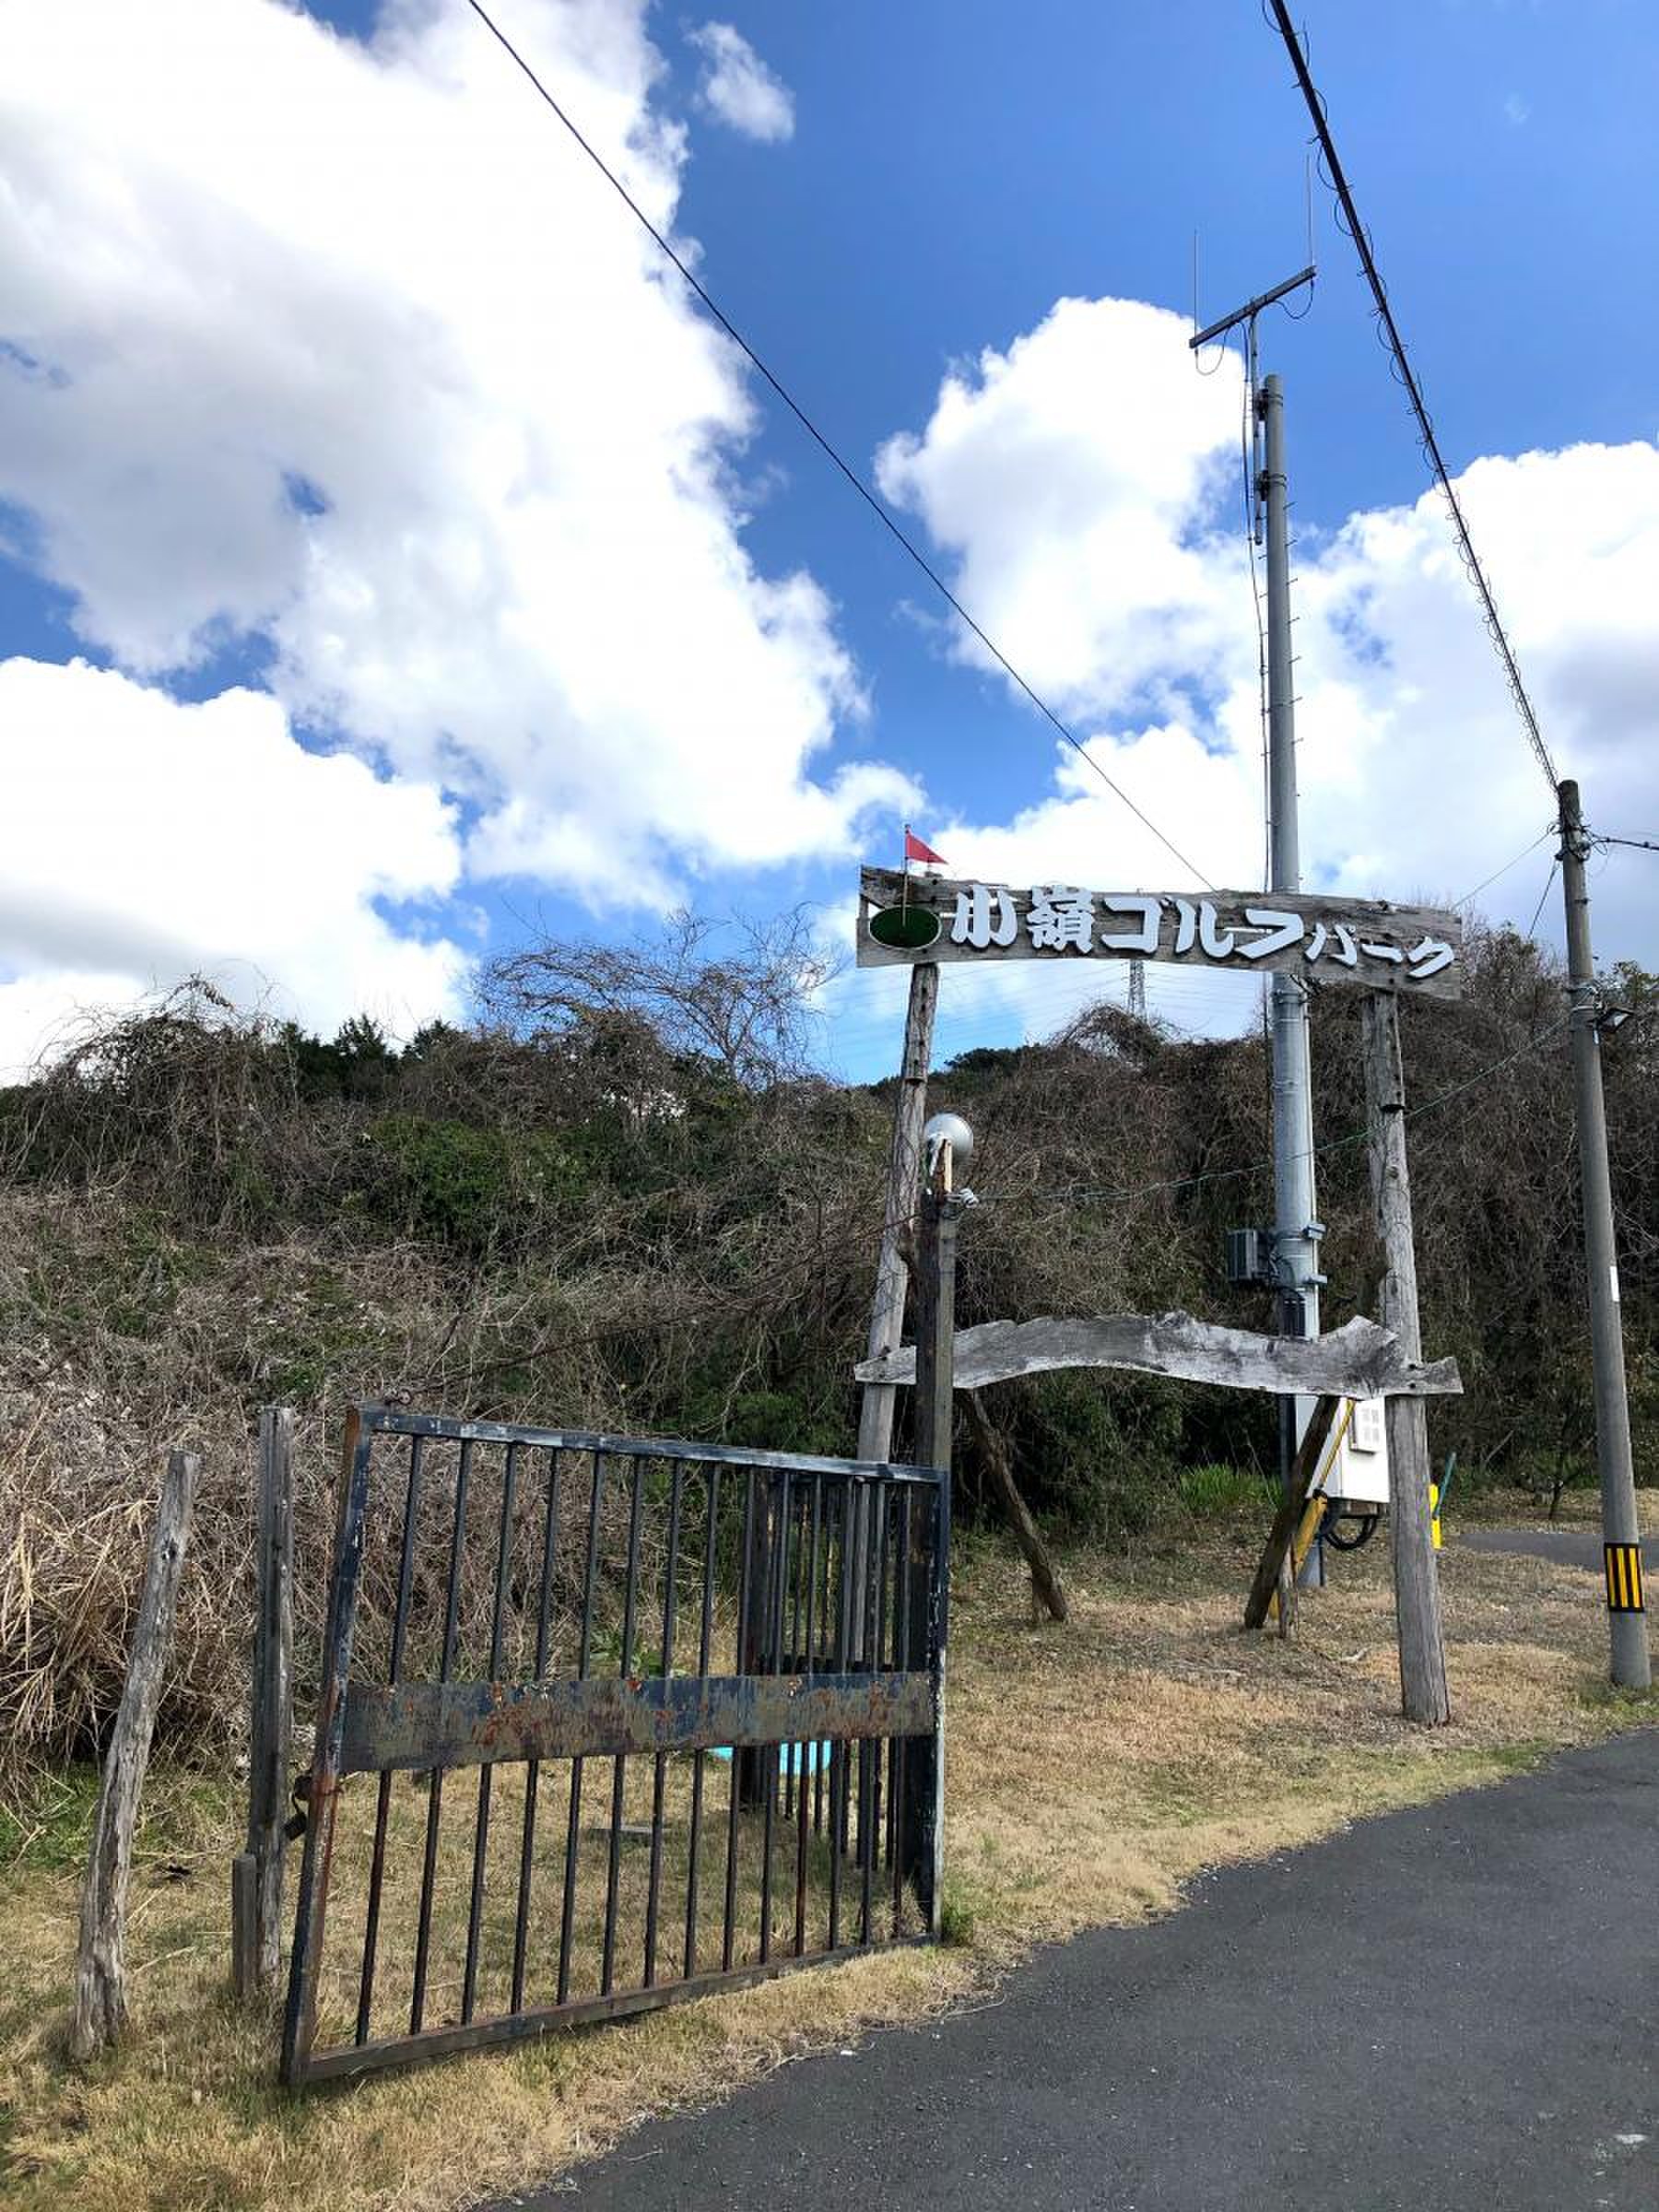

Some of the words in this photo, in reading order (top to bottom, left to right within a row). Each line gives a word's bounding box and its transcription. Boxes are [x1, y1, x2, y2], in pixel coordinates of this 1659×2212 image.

[950, 884, 1455, 979] 小嶺ゴルフパーク
